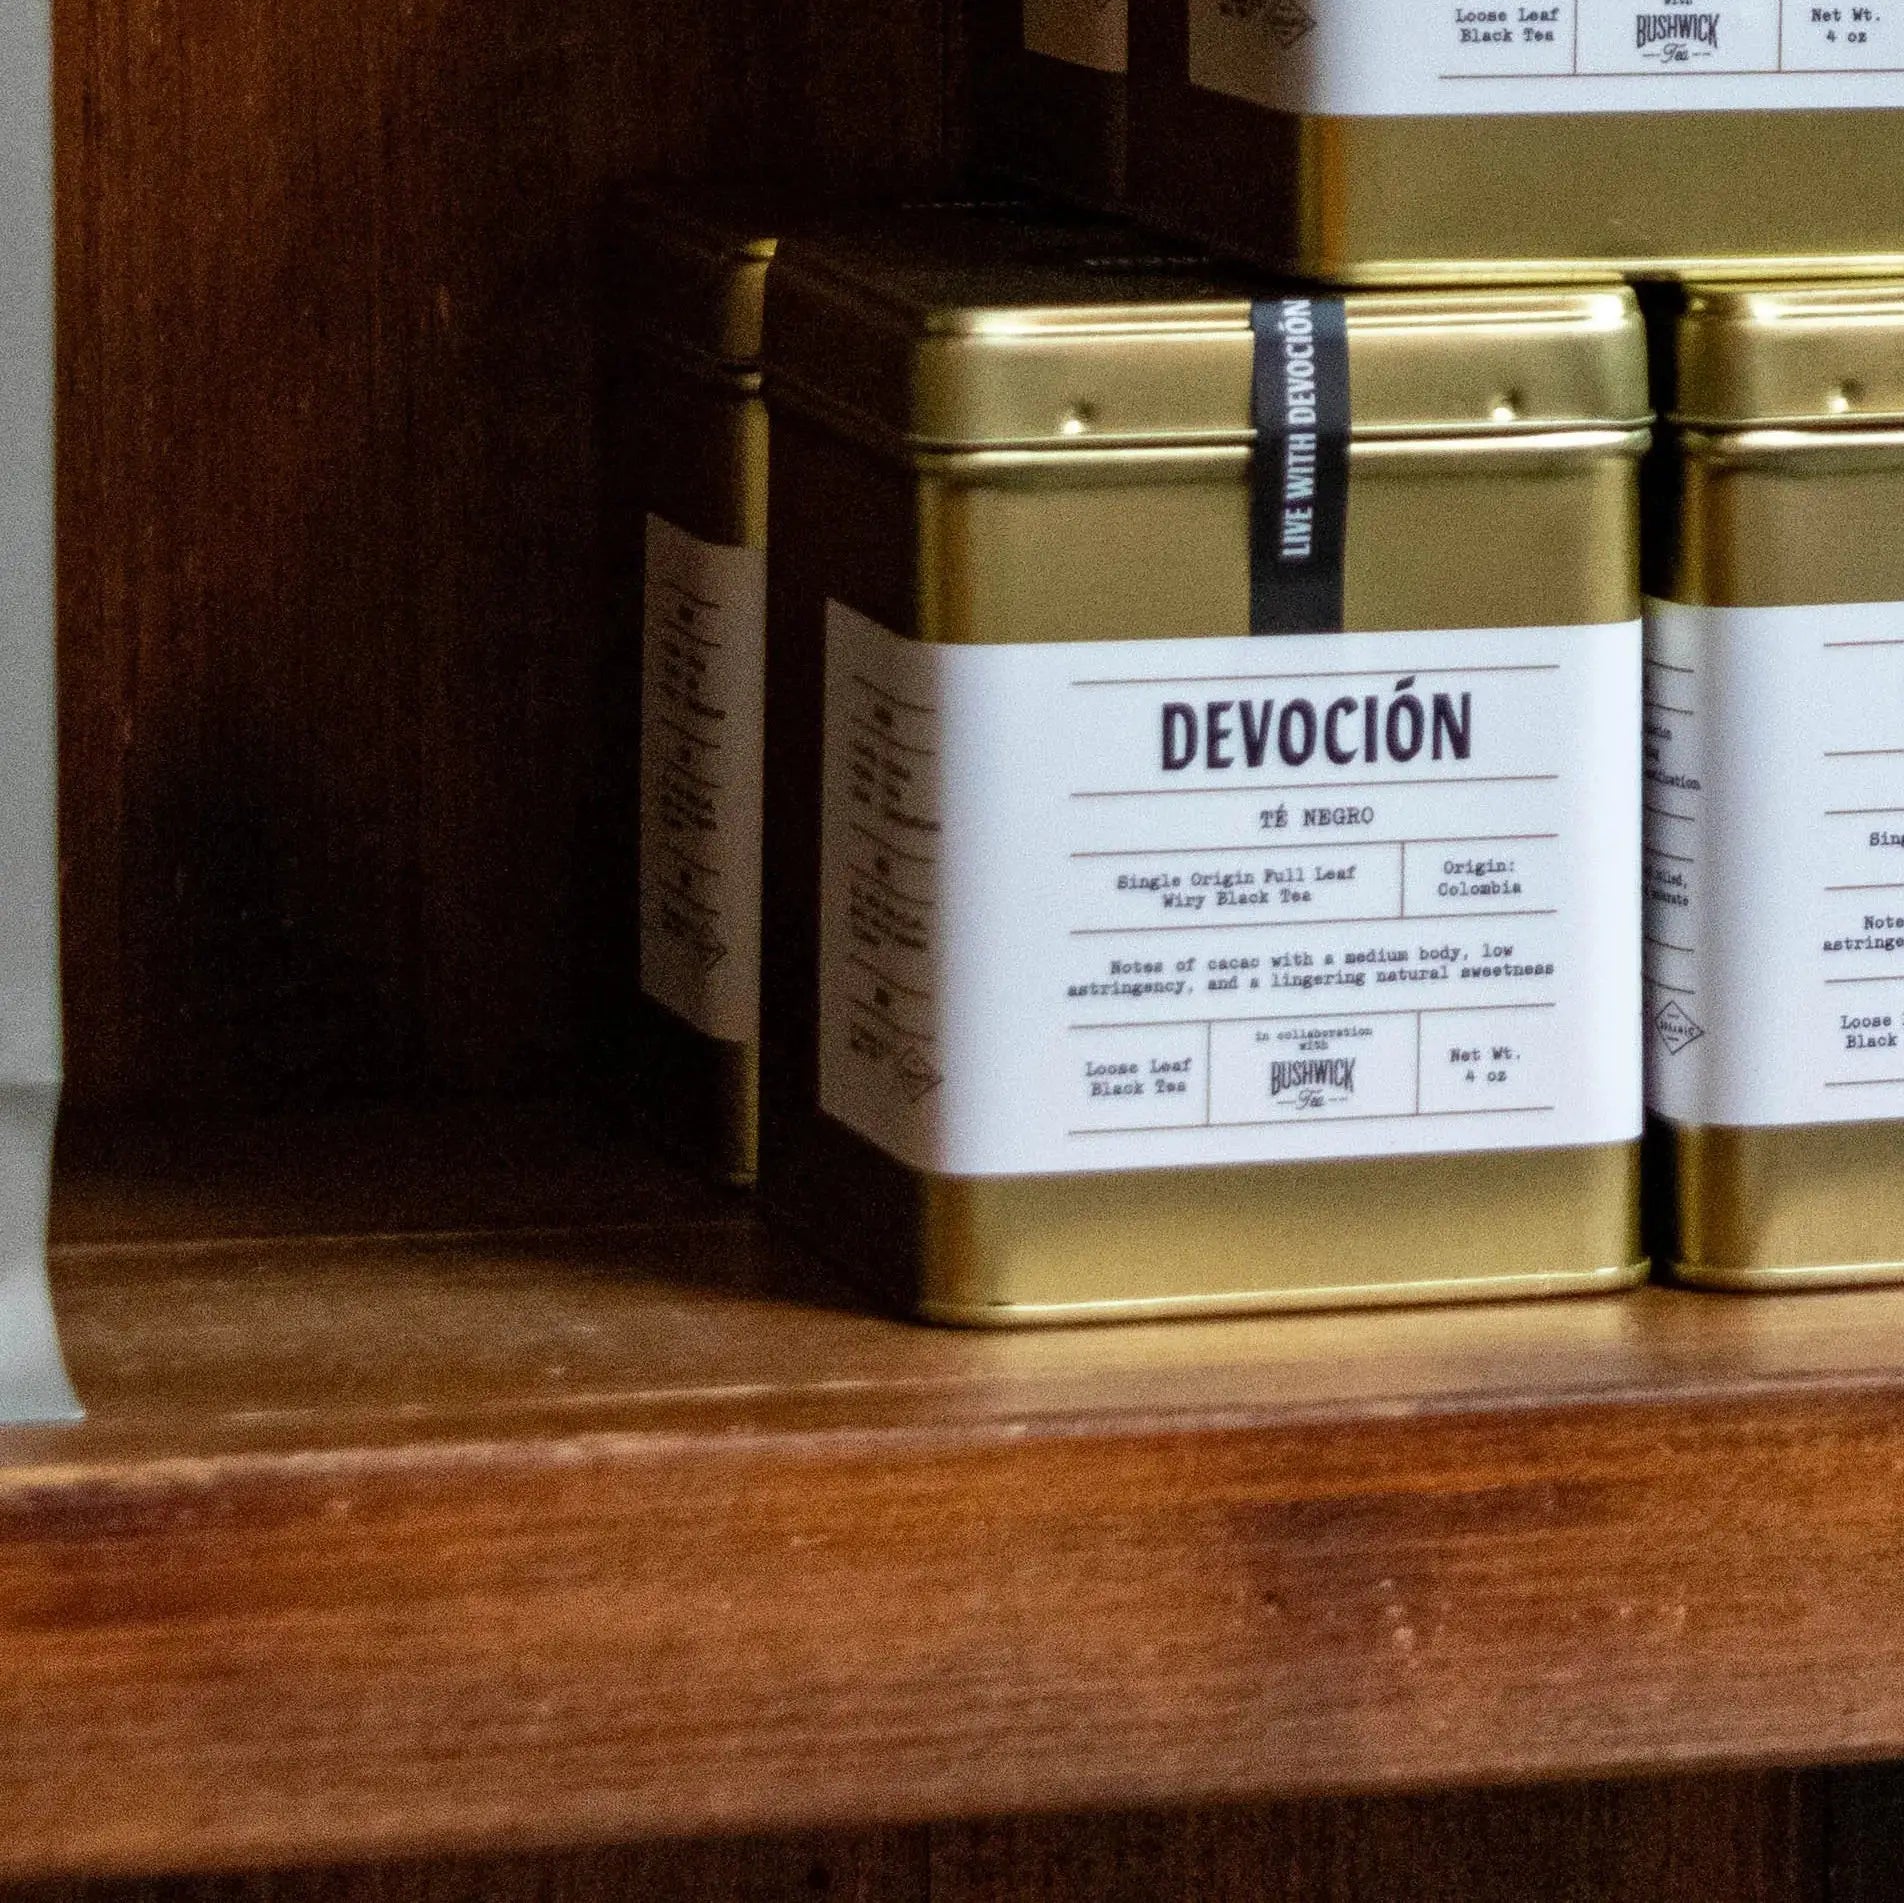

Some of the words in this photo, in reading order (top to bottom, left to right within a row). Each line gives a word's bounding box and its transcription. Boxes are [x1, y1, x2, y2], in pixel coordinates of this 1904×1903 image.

[1455, 8, 1507, 24] Loose
[1518, 7, 1560, 23] Leaf
[1811, 8, 1841, 23] Net
[1851, 7, 1880, 22] Wt.
[1459, 28, 1513, 44] Black
[1523, 27, 1554, 42] Tea
[1635, 13, 1720, 49] BUSHWICK
[1826, 29, 1837, 43] 4
[1847, 31, 1867, 44] oz
[1279, 300, 1315, 424] DEVOCIÓN
[1286, 433, 1315, 498] WITH
[1283, 507, 1312, 557] LIVE
[1161, 673, 1471, 771] DEVOCIÓN
[1259, 803, 1288, 829] TÉ
[1303, 806, 1374, 827] NEGRO
[1443, 859, 1514, 877] Origin:
[1116, 874, 1181, 893] Single
[1191, 872, 1254, 889] Origin
[1264, 868, 1304, 884] Full
[1314, 865, 1356, 882] Leaf
[1437, 880, 1522, 897] Colombia
[1162, 893, 1205, 910] Wiry
[1216, 890, 1268, 906] Black
[1280, 888, 1311, 903] Tea
[1110, 960, 1163, 975] Notes
[1175, 957, 1196, 973] of
[1208, 958, 1259, 971] cacao
[1271, 952, 1313, 968] with
[1324, 954, 1334, 965] a
[1344, 948, 1409, 965] medium
[1419, 945, 1468, 963] body,
[1482, 943, 1513, 958] low
[1067, 981, 1193, 998] astringency,
[1207, 975, 1239, 992] and
[1250, 978, 1259, 989] a
[1271, 970, 1366, 990] lingering
[1376, 965, 1449, 983] natural
[1460, 963, 1555, 979] sweetness
[1840, 1015, 1892, 1030] Loose
[1845, 1032, 1897, 1050] Black
[1450, 1048, 1481, 1063] Net
[1491, 1046, 1520, 1061] Wt.
[1085, 1062, 1138, 1078] Loose
[1150, 1057, 1192, 1074] Leaf
[1271, 1057, 1355, 1097] BUSHWICK
[1465, 1070, 1475, 1082] 4
[1487, 1070, 1507, 1082] oz
[1090, 1081, 1144, 1097] Black
[1155, 1078, 1186, 1094] Tea
